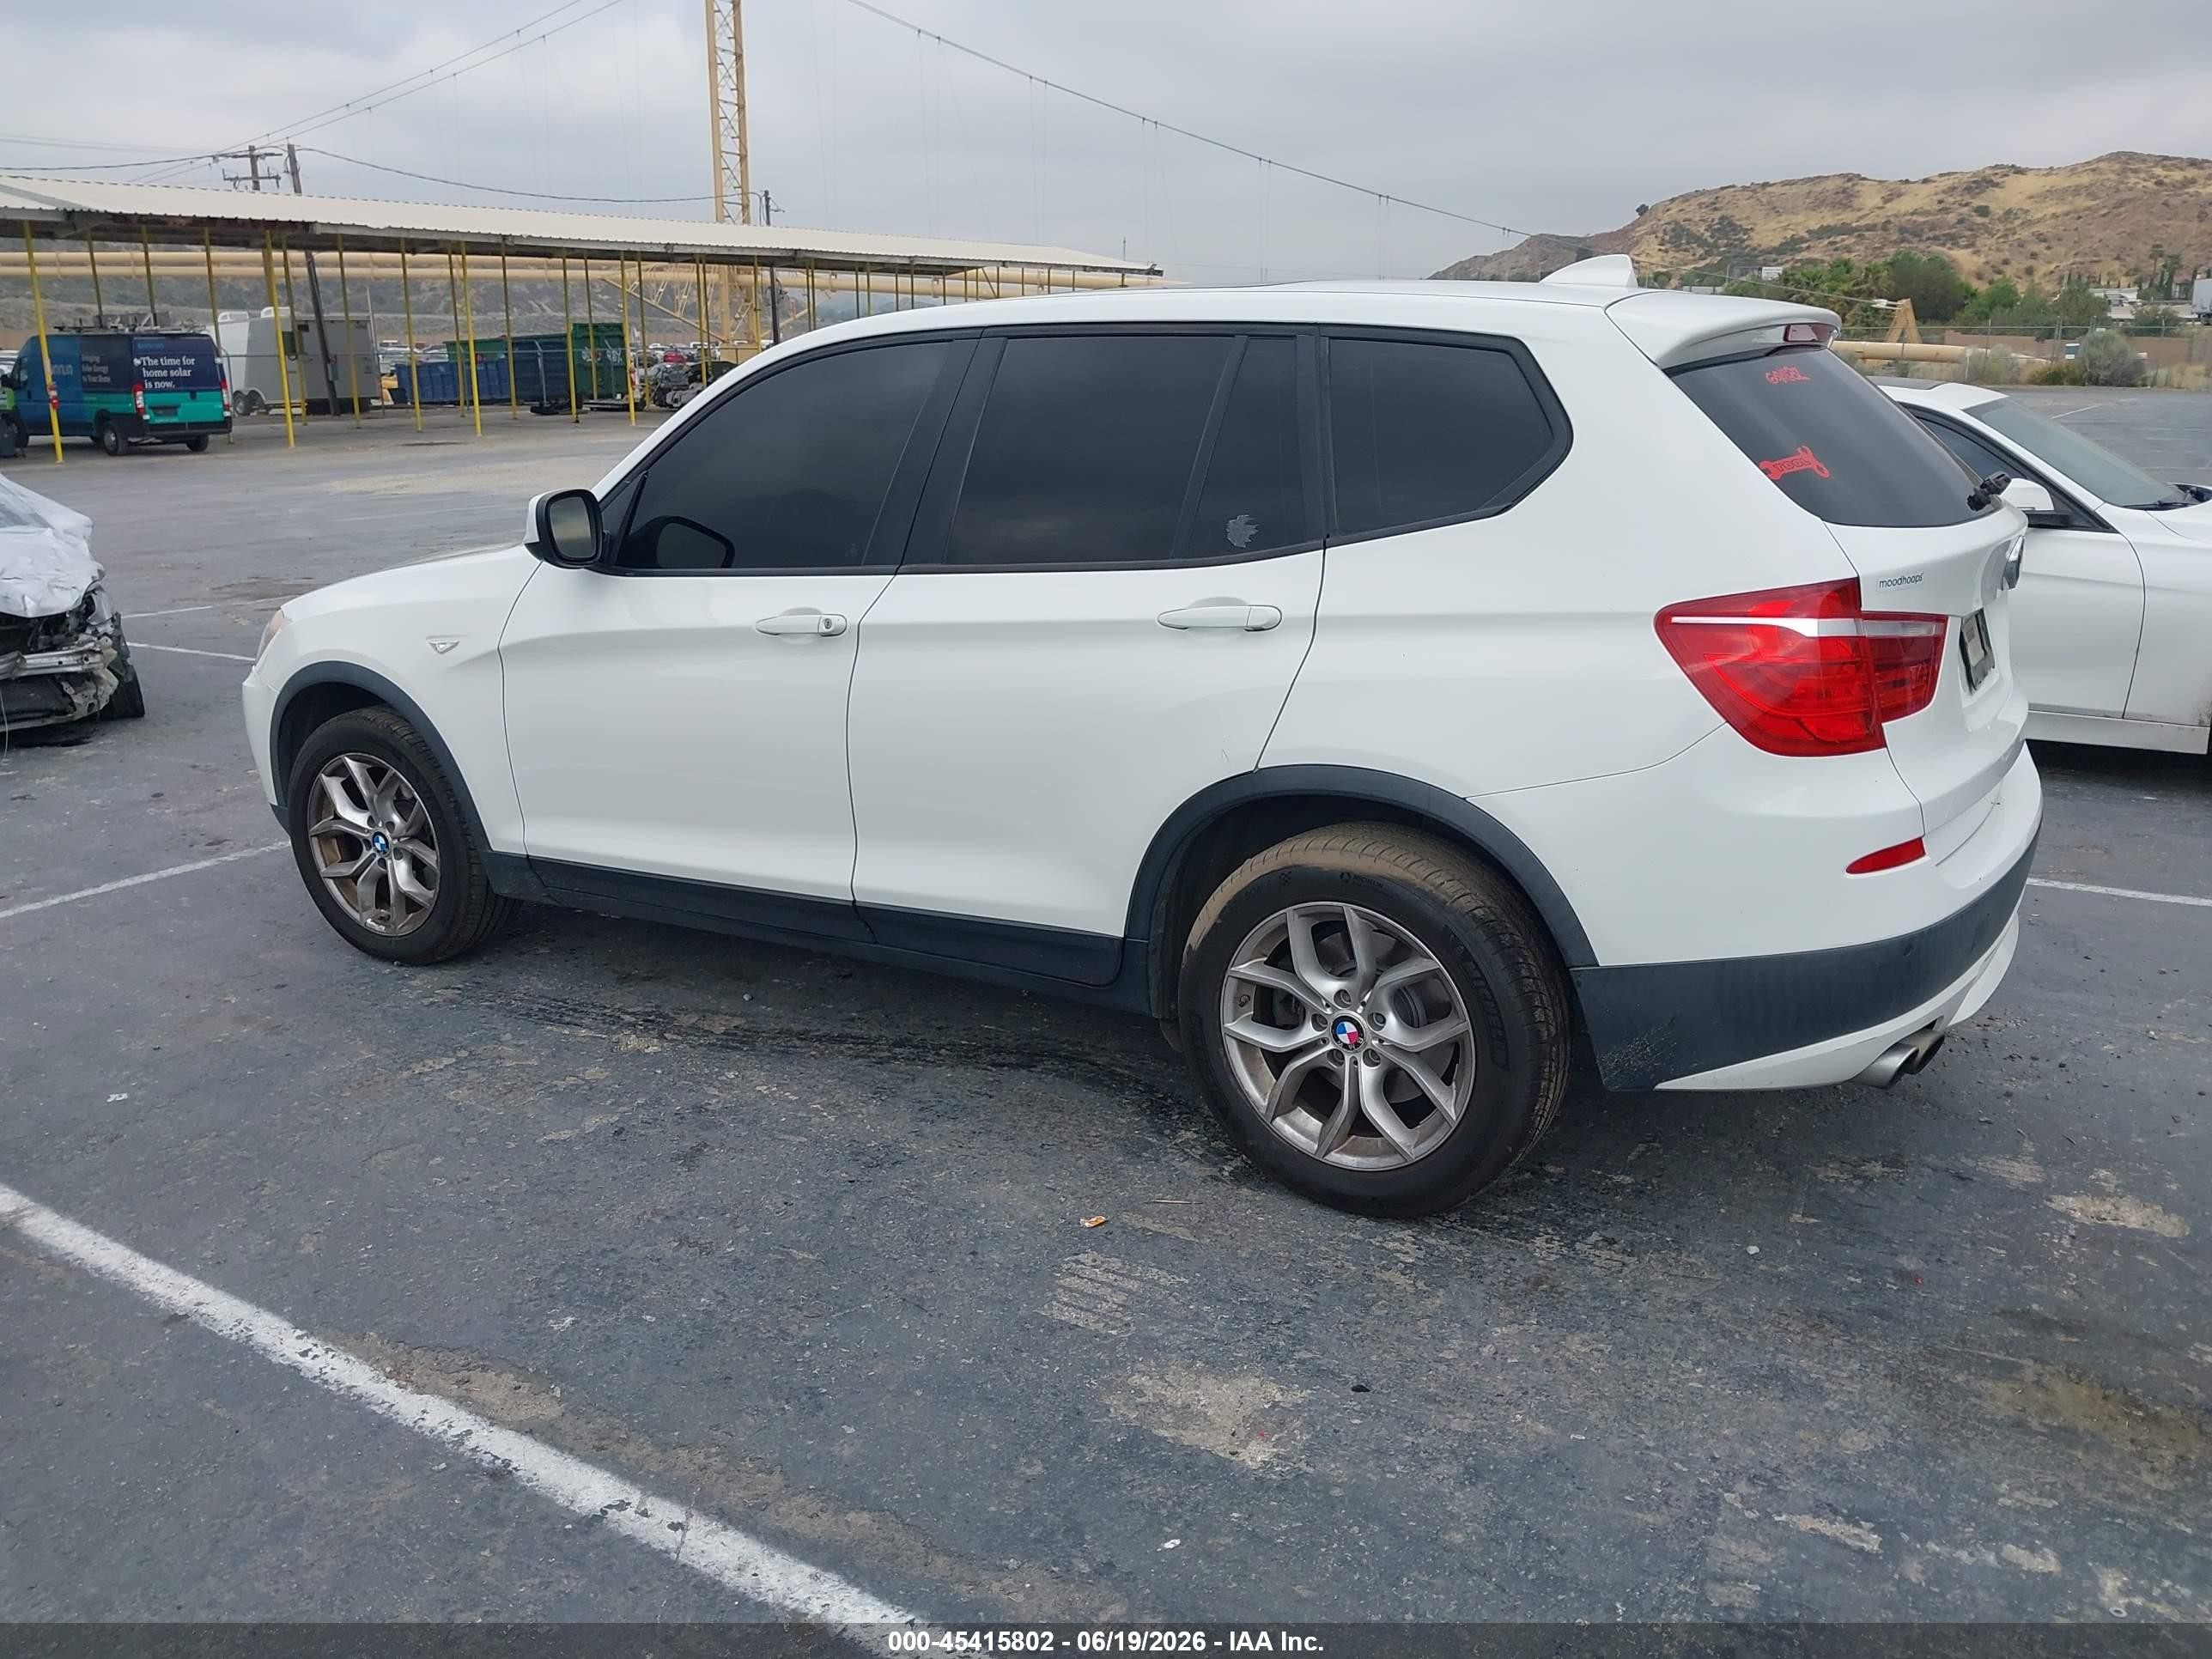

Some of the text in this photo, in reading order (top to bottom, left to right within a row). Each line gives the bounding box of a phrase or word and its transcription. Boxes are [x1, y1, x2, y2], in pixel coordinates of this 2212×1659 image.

[140, 356, 196, 366] The time for
[142, 367, 192, 378] home solar
[144, 380, 176, 389] is now.
[1771, 457, 1812, 472] TOOL
